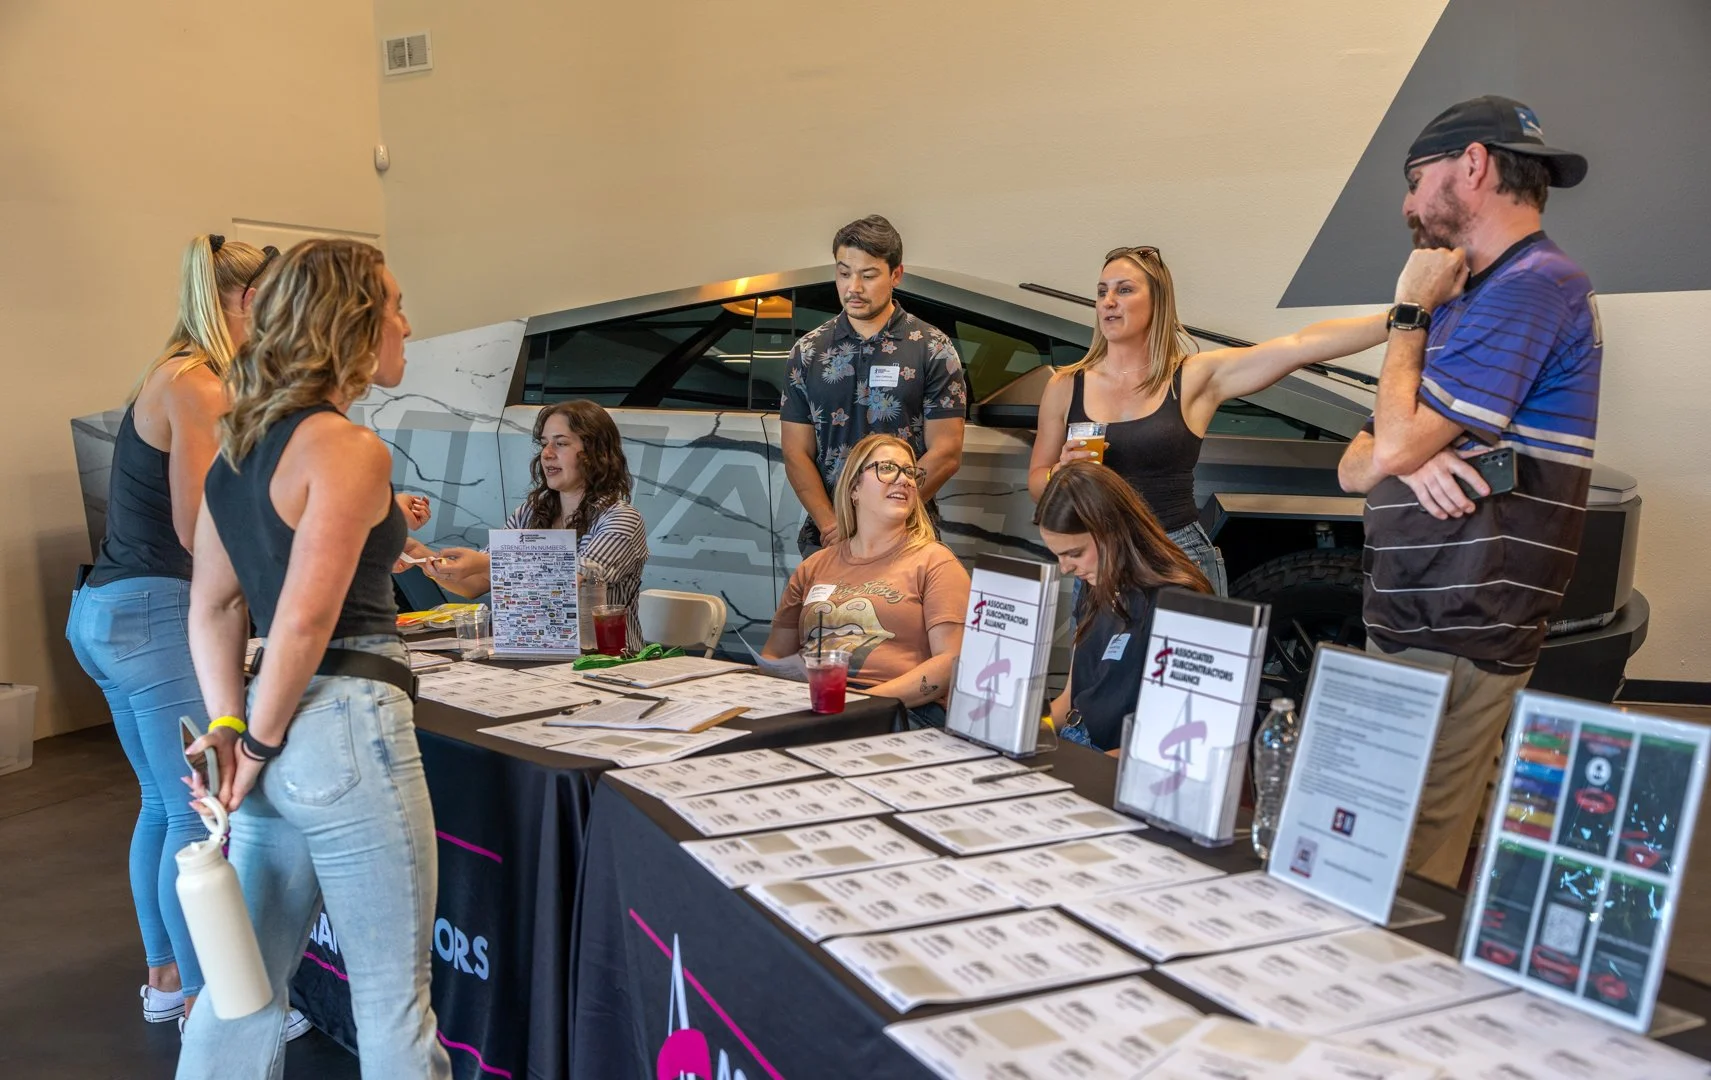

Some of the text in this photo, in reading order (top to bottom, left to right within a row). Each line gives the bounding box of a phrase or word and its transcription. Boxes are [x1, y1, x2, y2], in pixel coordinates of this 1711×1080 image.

[987, 599, 1016, 613] ASSOCIATED
[983, 618, 1007, 631] ALLIANCE
[985, 608, 1029, 627] SUBCONTRACTORS
[1174, 647, 1214, 664] ASSOCIATED
[1169, 670, 1201, 686] ALLIANCE
[1172, 658, 1234, 682] SUBCONTRACTORS
